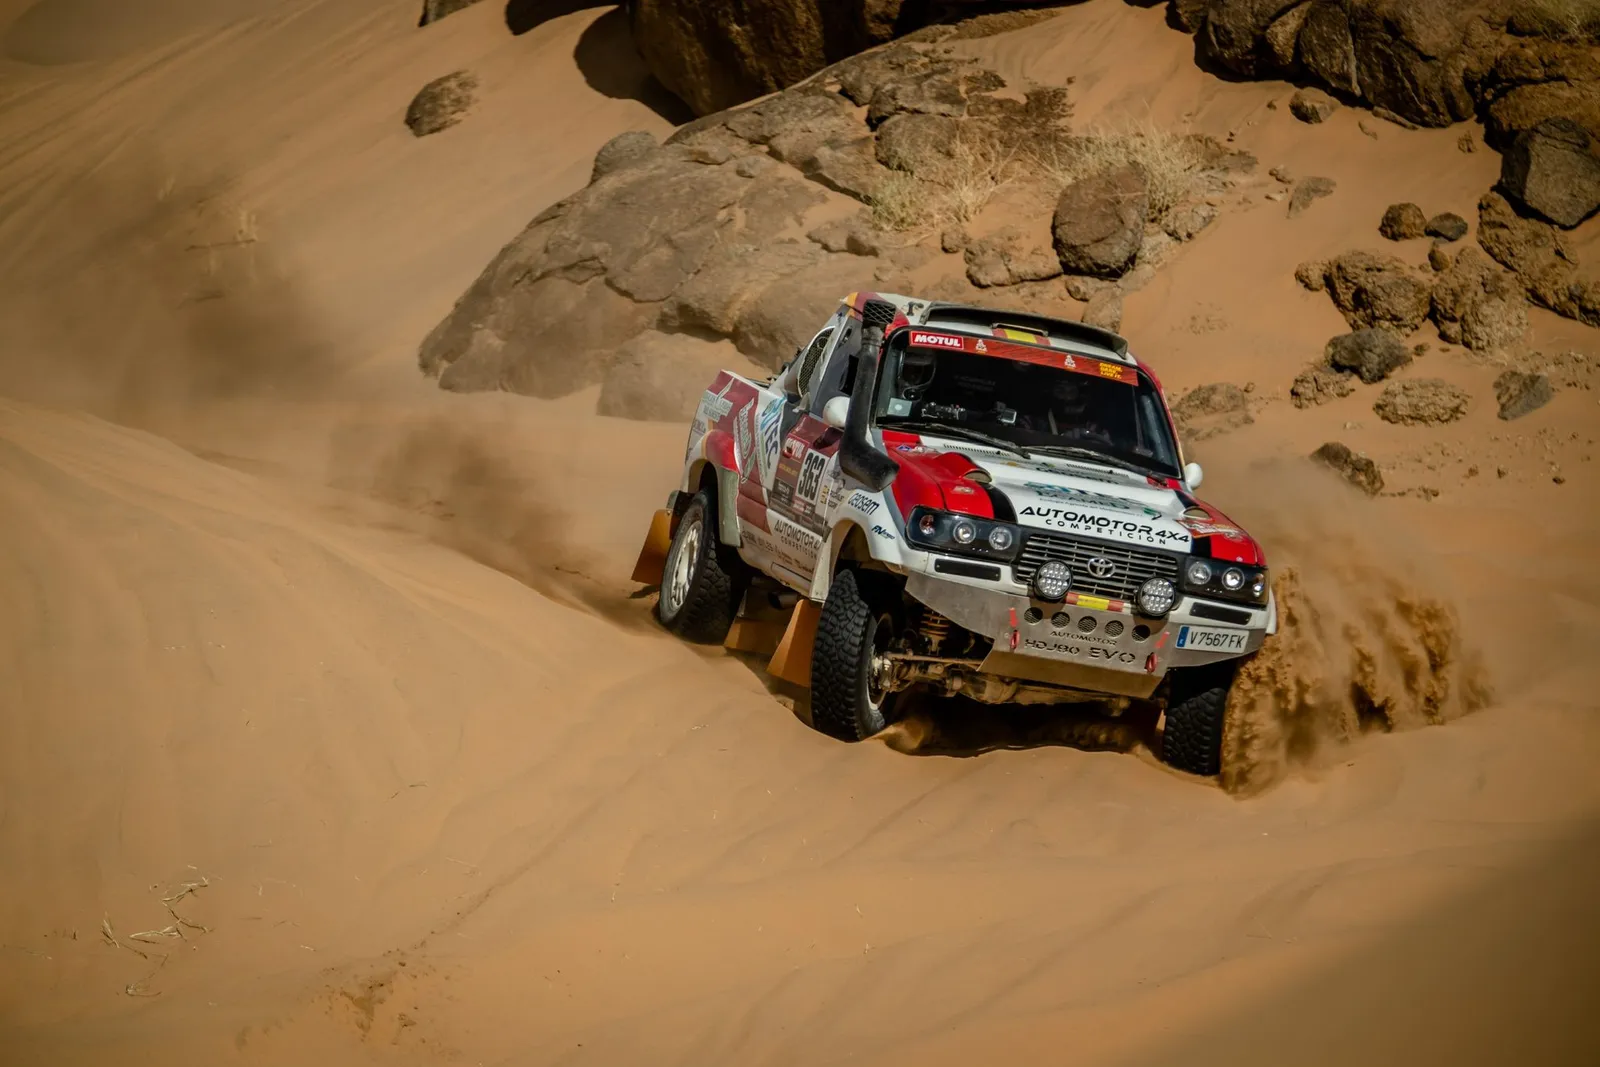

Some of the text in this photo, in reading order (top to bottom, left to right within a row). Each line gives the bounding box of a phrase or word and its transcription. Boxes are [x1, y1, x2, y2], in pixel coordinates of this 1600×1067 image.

[914, 334, 961, 347] MOTUL
[798, 452, 826, 500] 363
[1019, 506, 1190, 543] AUTOMOTOR 4X4
[774, 520, 815, 549] AUTOMOTOR
[1050, 630, 1118, 646] AUTOMOTOR
[1190, 631, 1198, 645] V
[1198, 631, 1230, 646] 7567
[1228, 634, 1246, 649] FK
[1089, 646, 1136, 663] EVO
